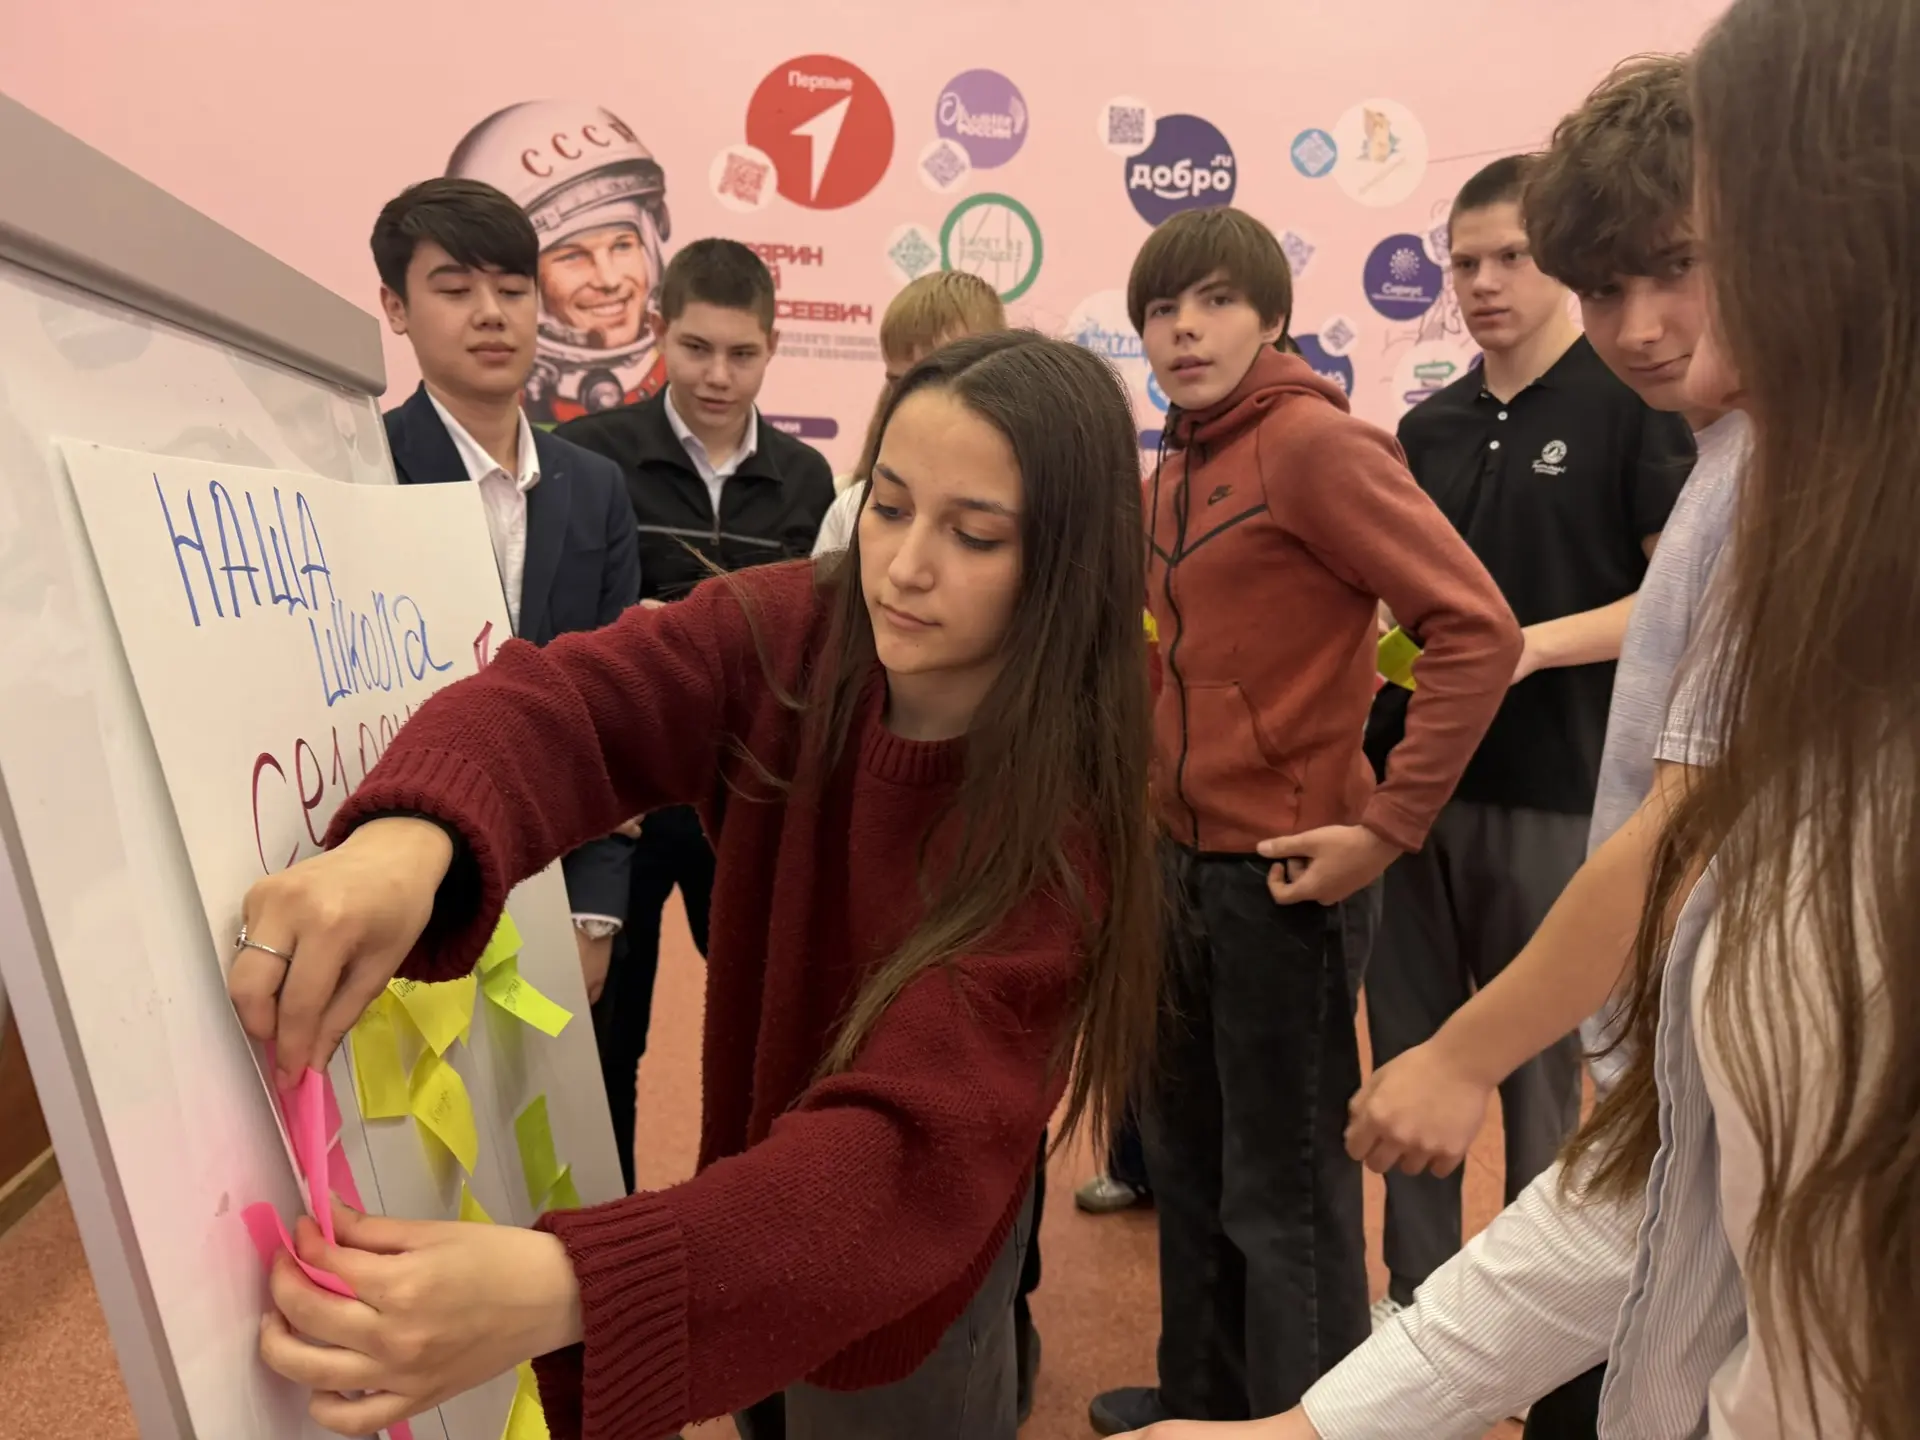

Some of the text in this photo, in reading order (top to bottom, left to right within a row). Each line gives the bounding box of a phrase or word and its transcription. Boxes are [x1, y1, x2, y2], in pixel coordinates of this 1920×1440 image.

[787, 69, 853, 93] Первые
[1129, 158, 1231, 198] добро
[743, 242, 823, 267] АРИН
[775, 300, 873, 324] СЕЕВИЧ
